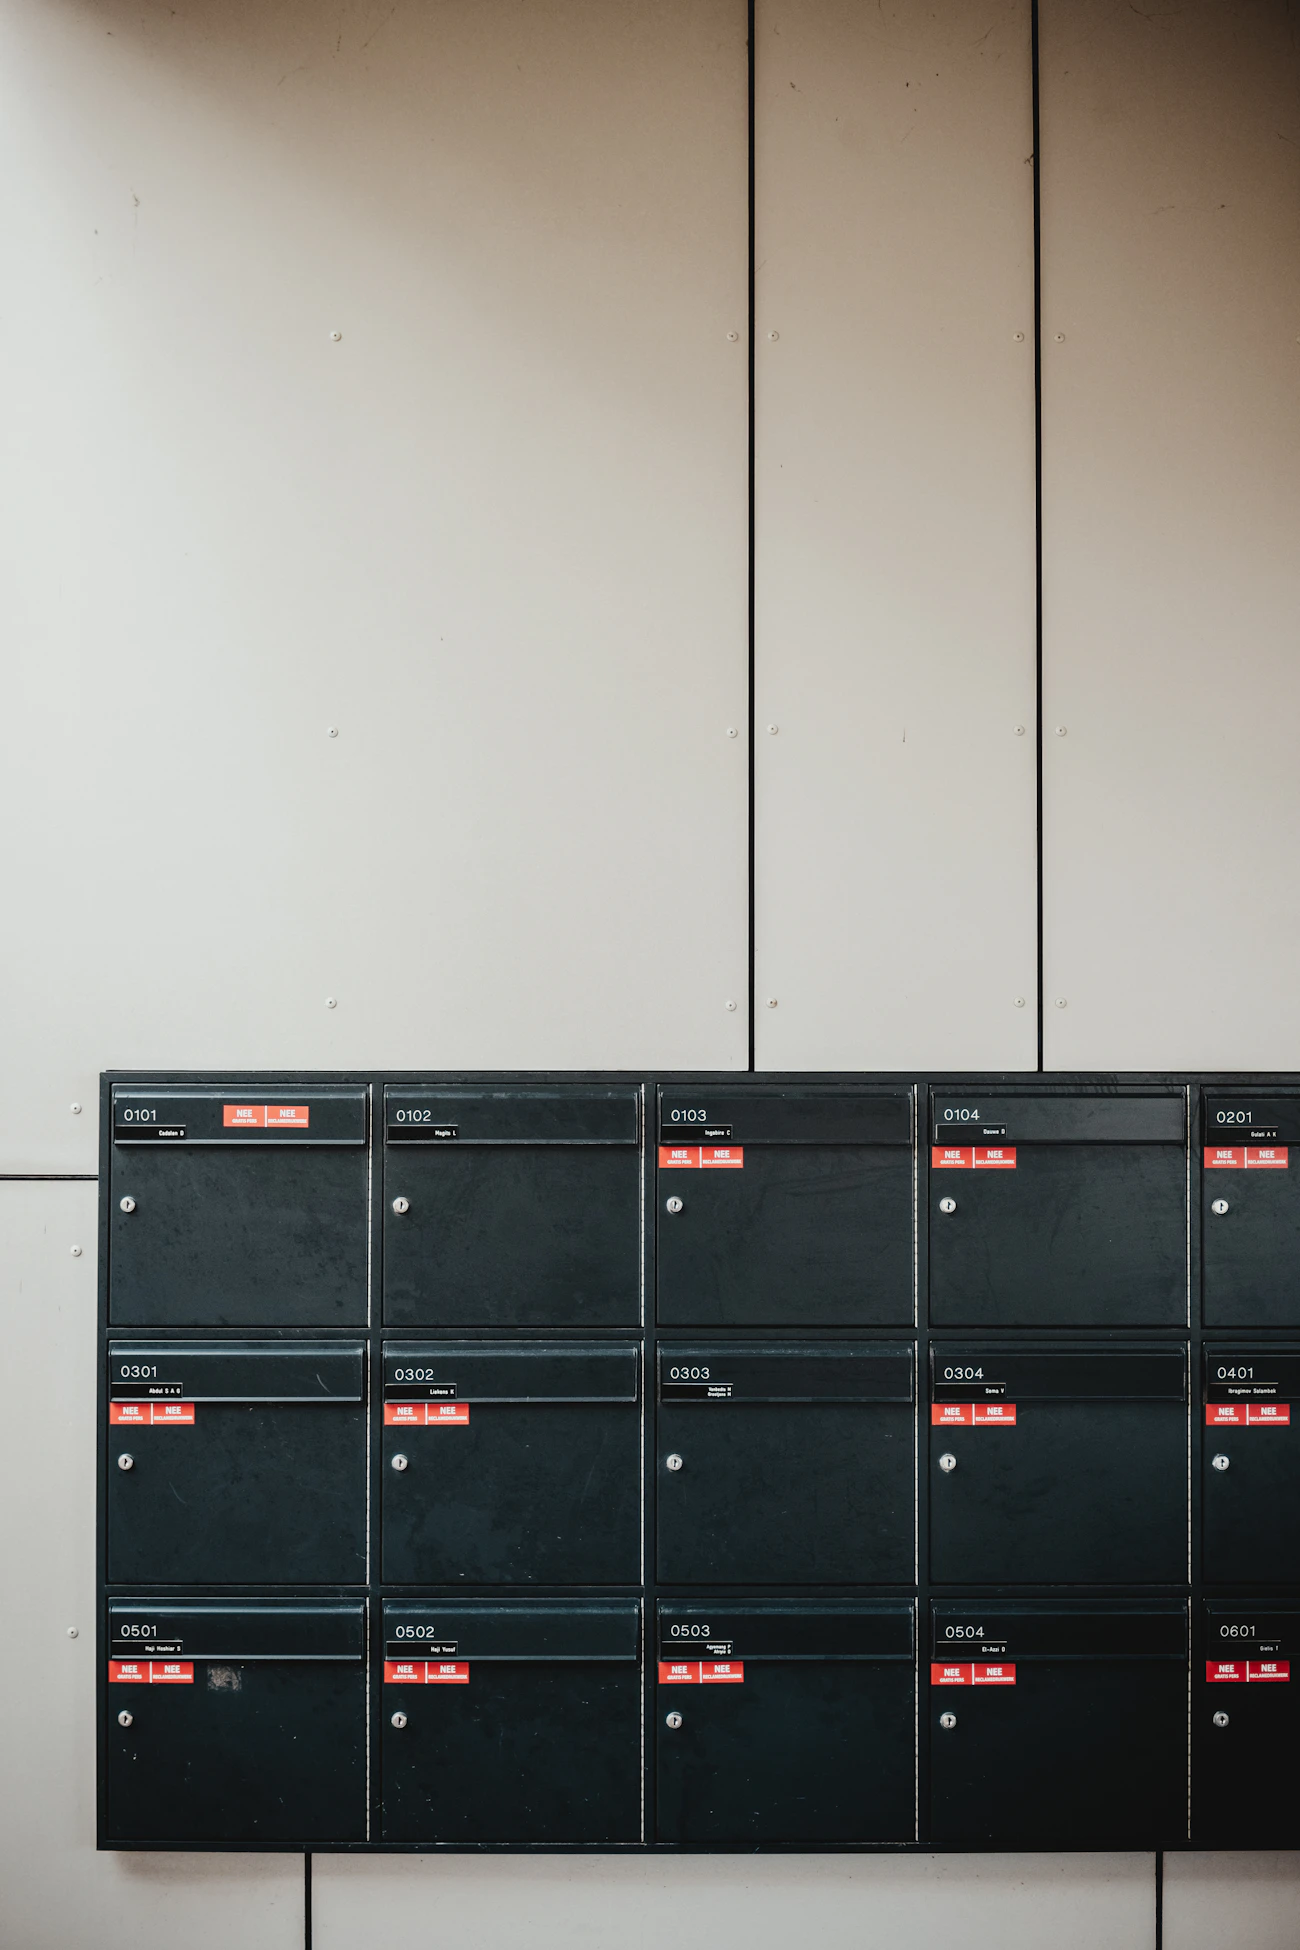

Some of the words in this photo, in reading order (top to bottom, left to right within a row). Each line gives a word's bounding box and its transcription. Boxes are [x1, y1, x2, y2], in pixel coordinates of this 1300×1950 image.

[124, 1109, 156, 1121] 0101
[236, 1109, 252, 1117] NEE
[279, 1109, 296, 1118] NEE
[396, 1110, 431, 1122] 0102
[671, 1109, 707, 1122] 0103
[944, 1109, 980, 1121] 0104
[1216, 1111, 1252, 1123] 0201
[671, 1150, 688, 1159] NEE
[714, 1150, 730, 1158] NEE
[944, 1151, 961, 1159] NEE
[987, 1150, 1003, 1158] NEE
[1216, 1151, 1232, 1159] NEE
[1259, 1150, 1275, 1158] NEE
[121, 1365, 157, 1378] 0301
[395, 1369, 434, 1381] 0302
[670, 1367, 710, 1379] 0303
[944, 1367, 984, 1379] 0304
[1217, 1367, 1253, 1379] 0401
[122, 1407, 139, 1415] NEE
[165, 1406, 182, 1414] NEE
[397, 1407, 413, 1415] NEE
[440, 1407, 456, 1415] NEE
[944, 1407, 960, 1416] NEE
[987, 1407, 1003, 1415] NEE
[1218, 1408, 1235, 1416] NEE
[1261, 1407, 1277, 1415] NEE
[121, 1625, 157, 1637] 0501
[396, 1626, 435, 1638] 0502
[671, 1625, 710, 1637] 0503
[945, 1626, 985, 1638] 0504
[1220, 1625, 1255, 1637] 0601
[121, 1665, 138, 1673] NEE
[164, 1665, 181, 1673] NEE
[397, 1665, 413, 1673] NEE
[440, 1665, 456, 1673] NEE
[671, 1666, 688, 1674] NEE
[714, 1665, 730, 1673] NEE
[987, 1668, 1003, 1676] NEE
[1218, 1665, 1235, 1673] NEE
[1261, 1664, 1277, 1672] NEE
[944, 1668, 960, 1677] NEE
